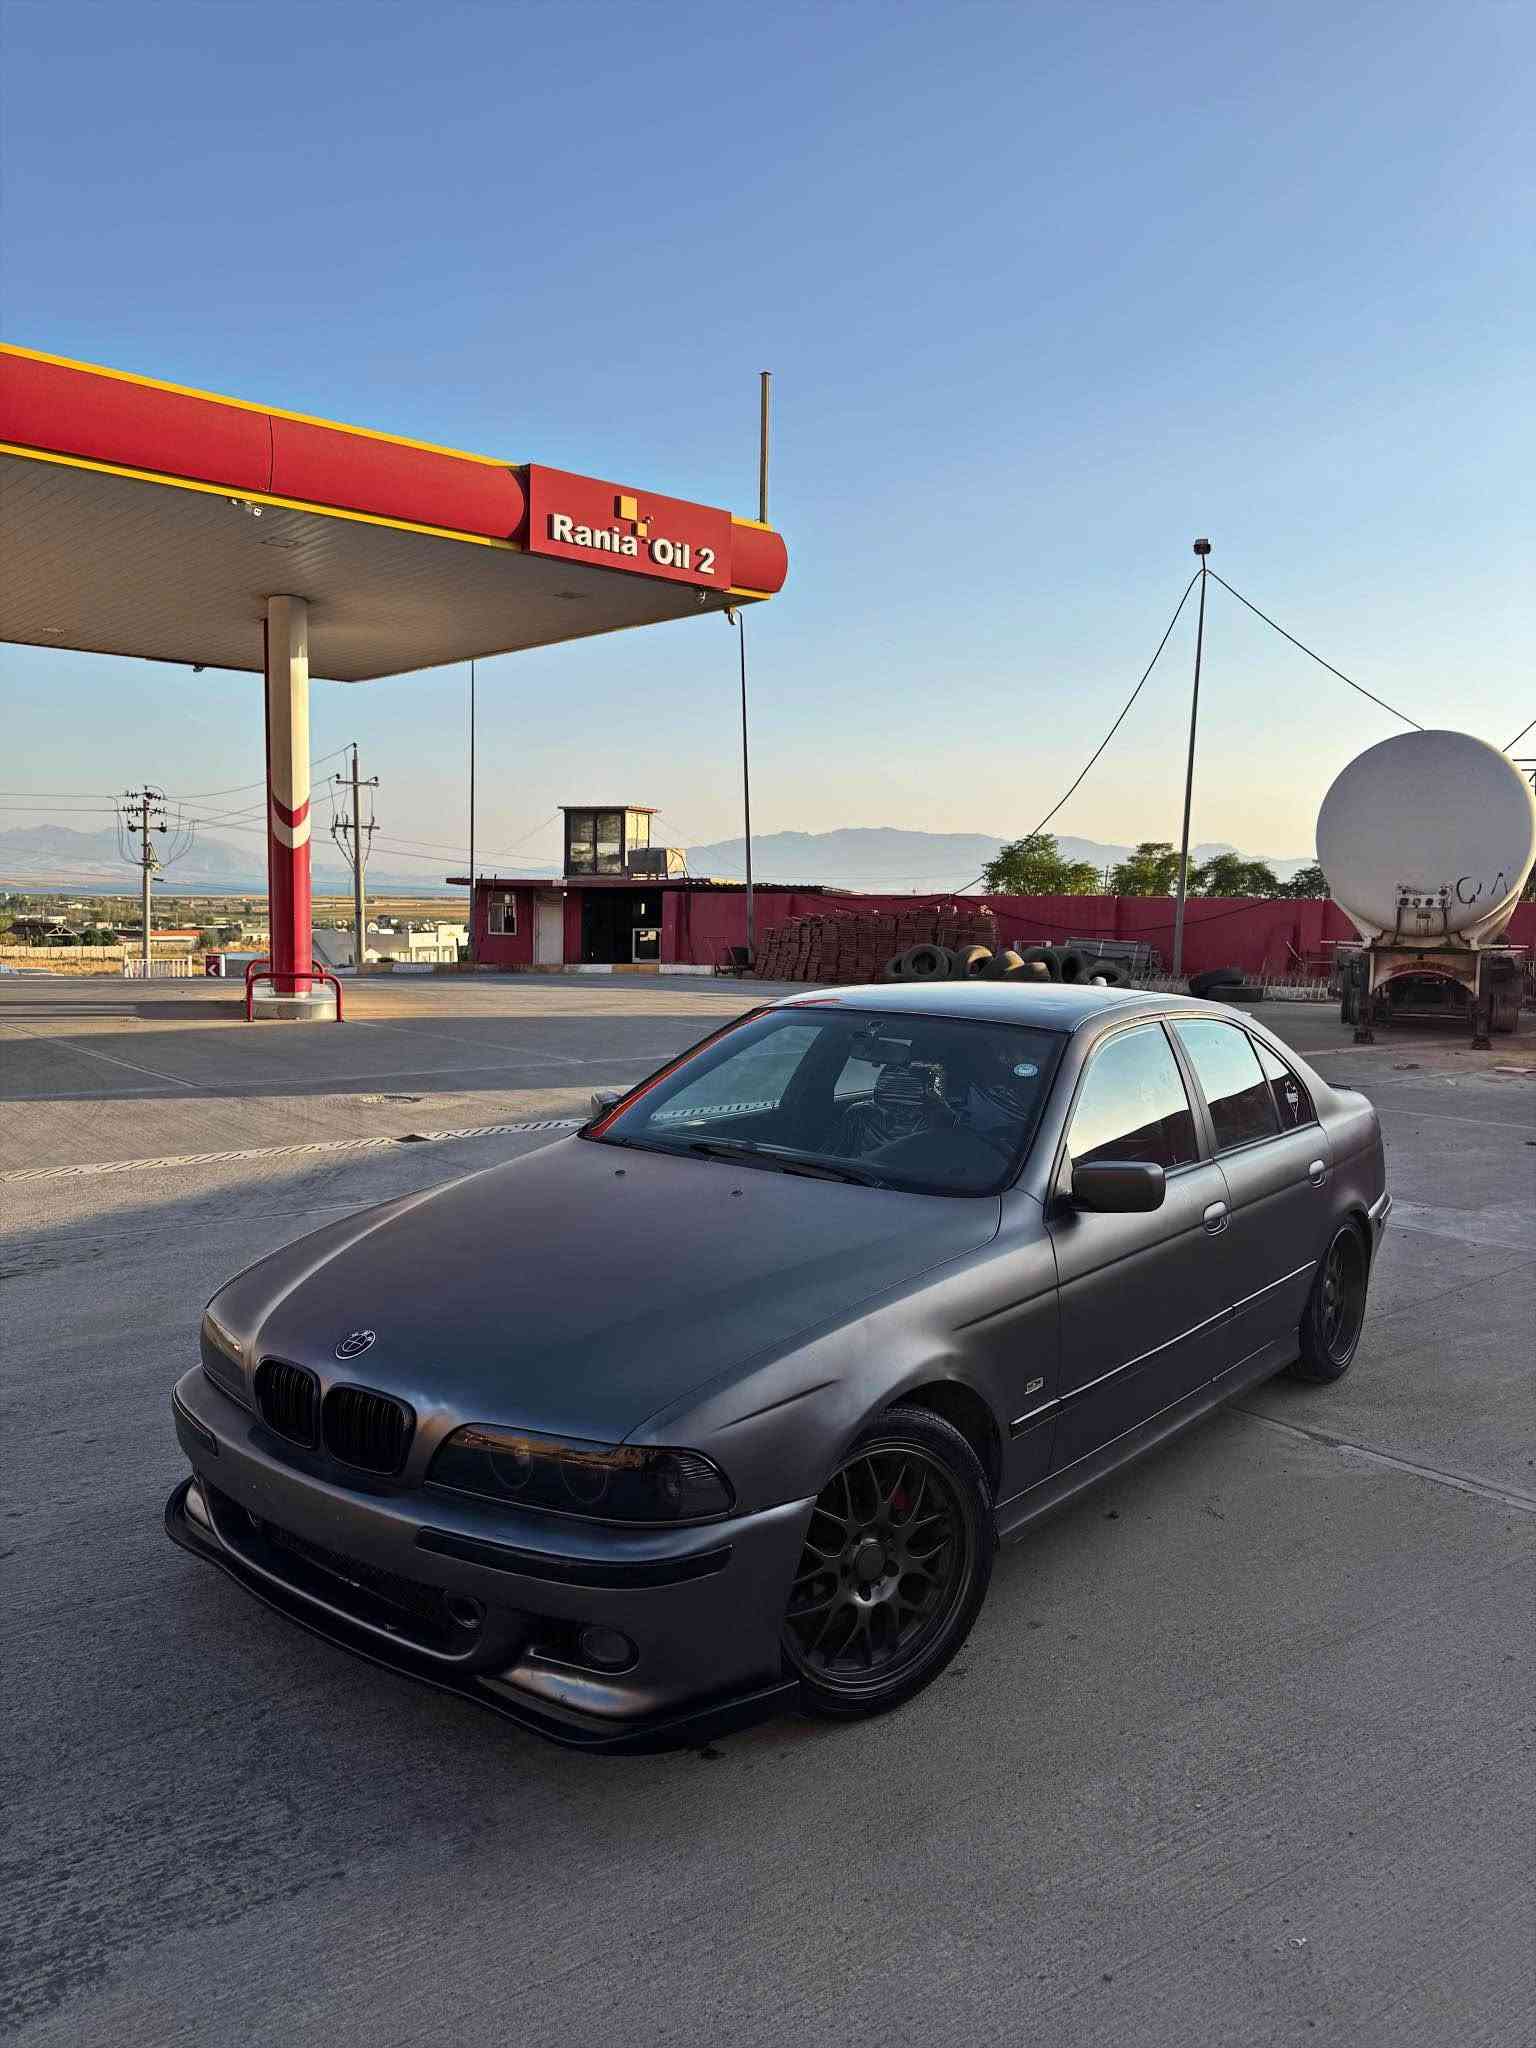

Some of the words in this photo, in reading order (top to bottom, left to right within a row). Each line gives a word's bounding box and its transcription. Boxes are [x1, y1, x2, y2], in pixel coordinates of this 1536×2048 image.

[551, 512, 638, 557] Rania
[652, 538, 690, 569] Oil
[698, 548, 716, 575] 2
